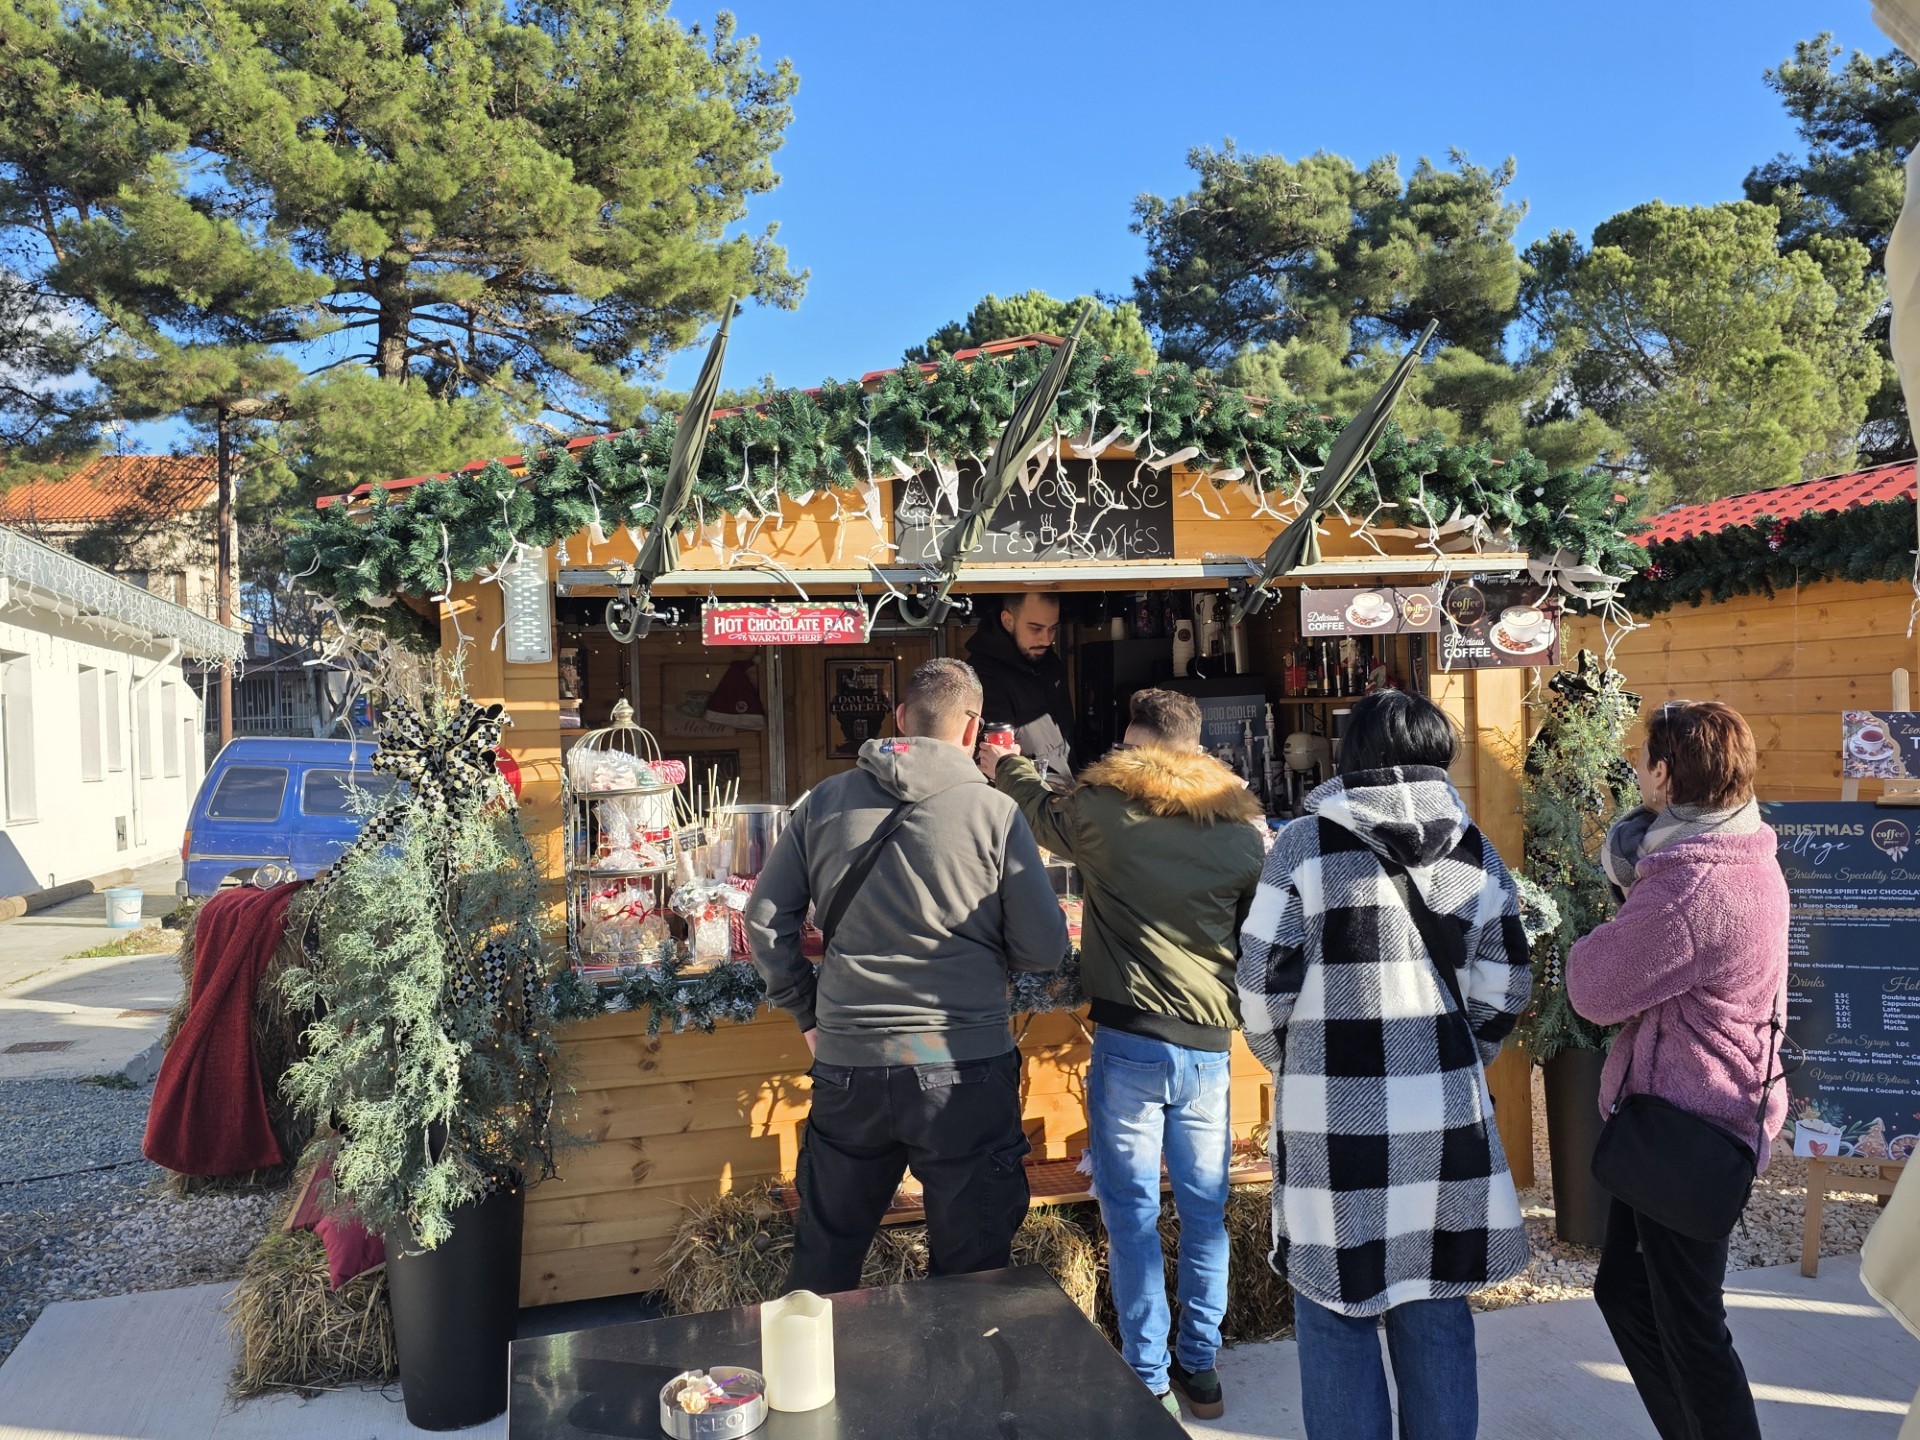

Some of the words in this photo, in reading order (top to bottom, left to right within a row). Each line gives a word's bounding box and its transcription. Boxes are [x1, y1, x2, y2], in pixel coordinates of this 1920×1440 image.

[1452, 597, 1480, 610] coffee
[713, 616, 744, 636] HOT
[747, 617, 820, 633] CHOCOLATE
[823, 616, 856, 634] BAR
[1308, 621, 1345, 631] COFFEE
[748, 634, 781, 643] WARM
[782, 634, 796, 642] UP
[797, 633, 823, 642] HERE
[1444, 647, 1492, 659] COFFEE
[1226, 705, 1257, 718] COOLER
[1771, 823, 1865, 836] HRISTMAS
[1876, 828, 1907, 841] coffee
[1777, 829, 1850, 866] illage
[1785, 867, 1833, 881] Christmas
[1787, 972, 1827, 988] Drinks
[1884, 1024, 1909, 1032] Matcha
[1825, 1033, 1853, 1046] Extra
[1855, 1034, 1890, 1050] Syrups
[1847, 1057, 1870, 1065] Ginger
[1871, 1051, 1903, 1059] Pistachio
[1810, 1067, 1843, 1084] Vegan
[1877, 1071, 1910, 1087] Options
[1841, 1085, 1869, 1093] Almond
[1875, 1087, 1905, 1095] Coconut
[694, 1412, 745, 1433] KEO
